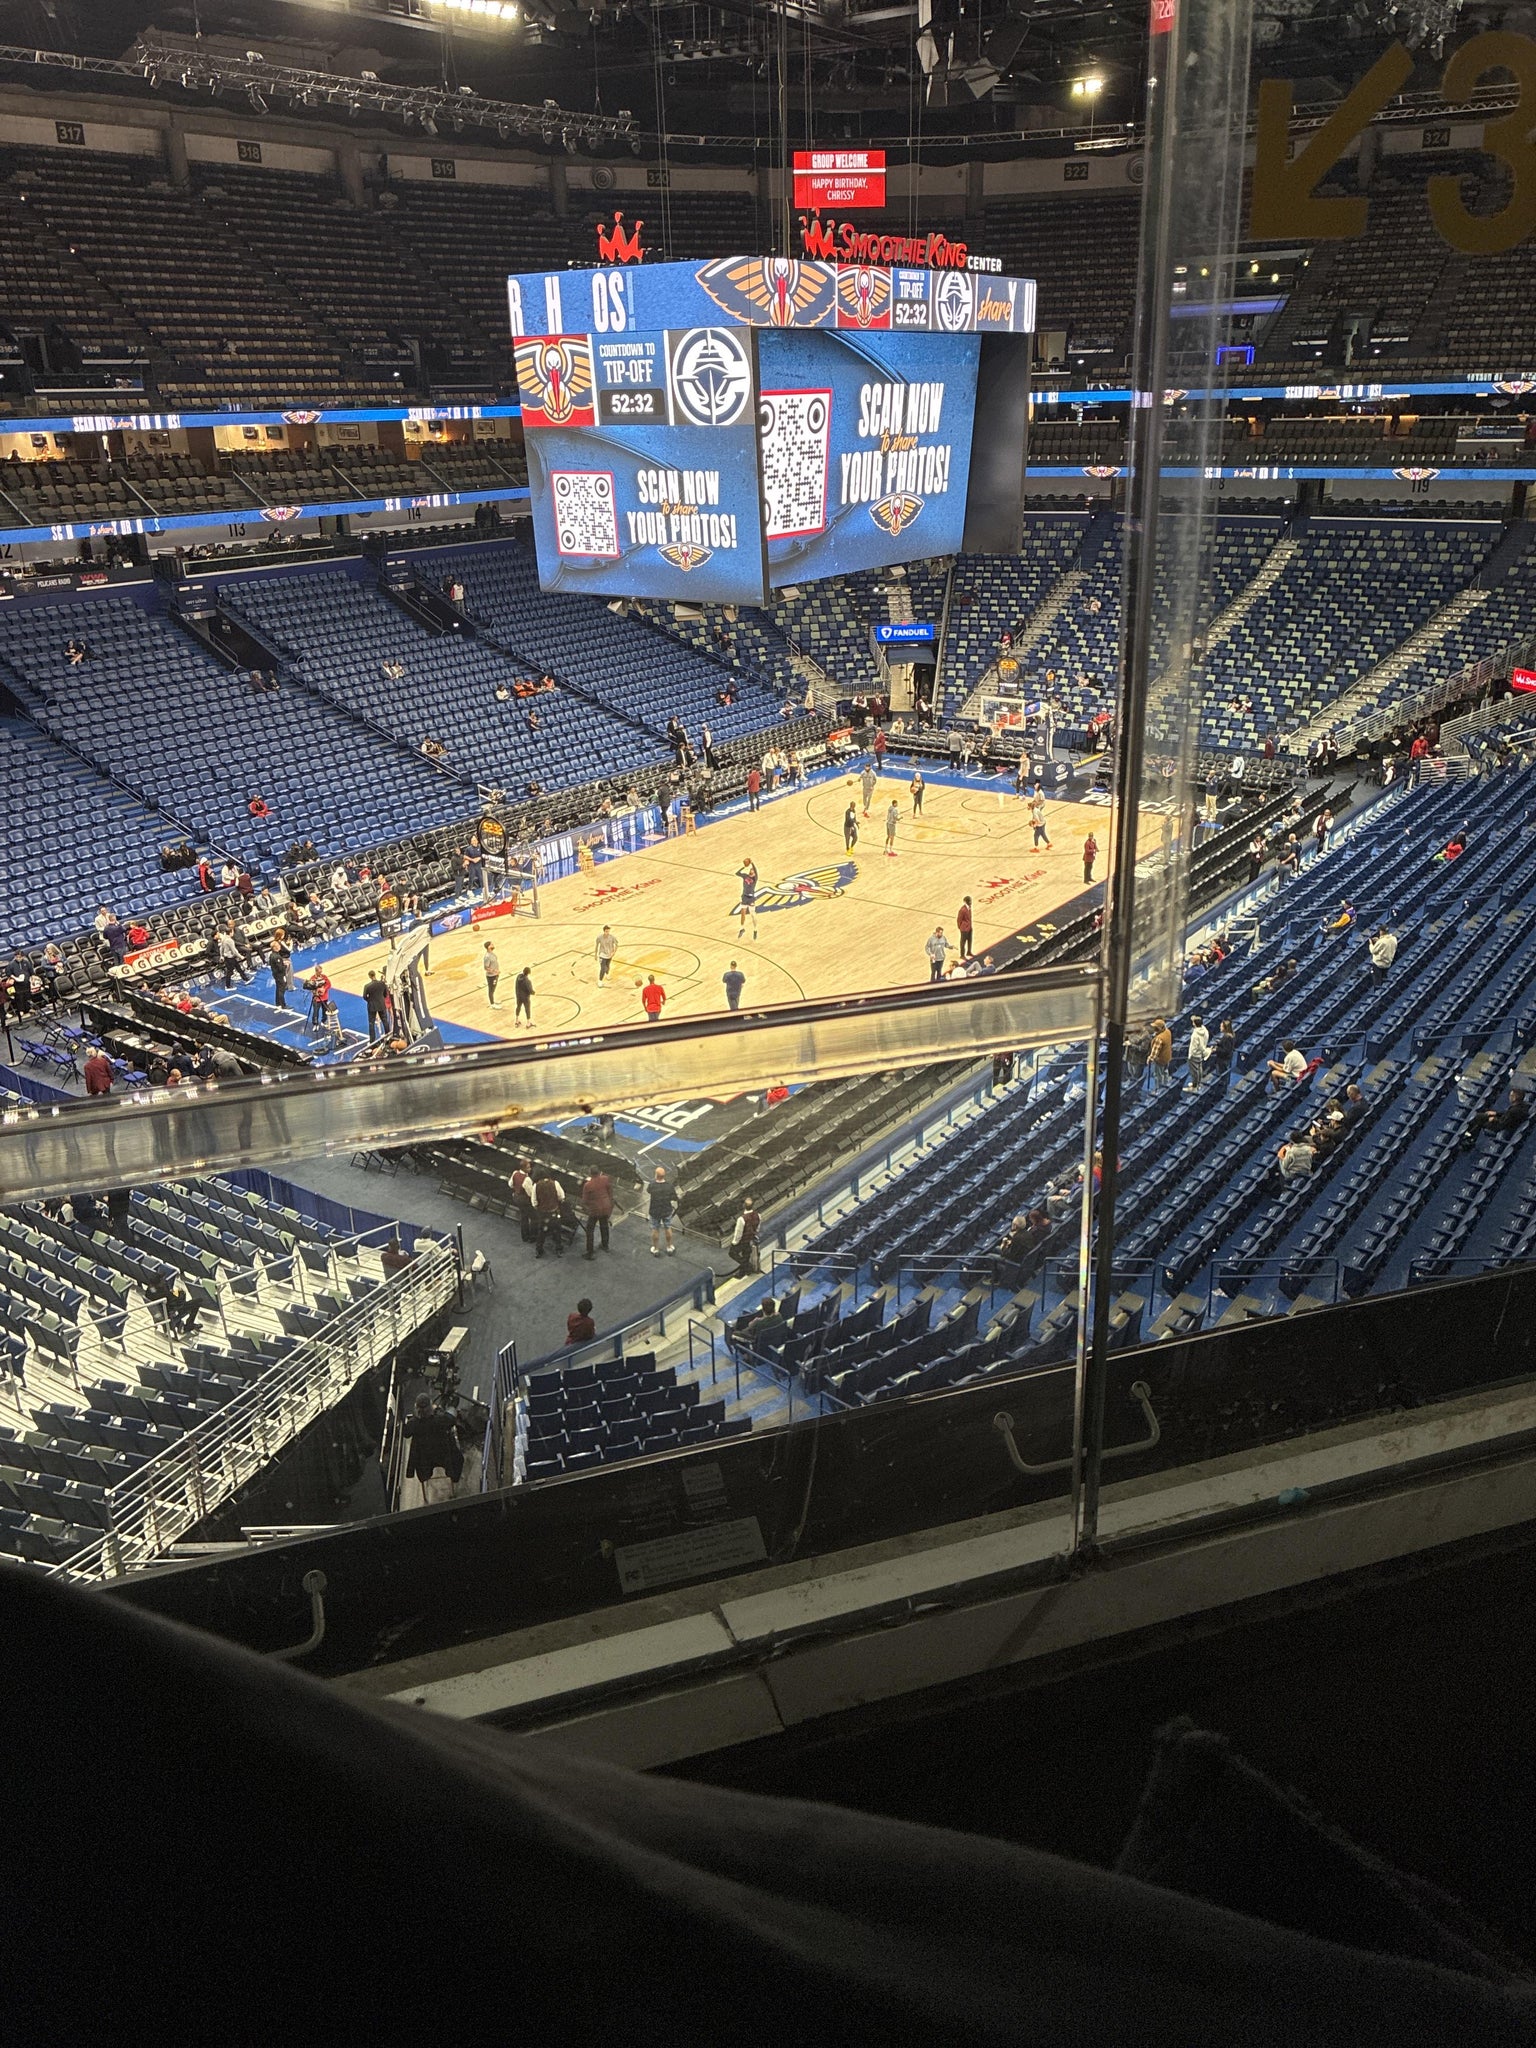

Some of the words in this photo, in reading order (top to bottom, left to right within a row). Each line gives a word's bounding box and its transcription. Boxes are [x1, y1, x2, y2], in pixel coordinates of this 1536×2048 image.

[59, 126, 81, 141] 317
[1424, 132, 1448, 145] 324
[240, 145, 260, 159] 318
[434, 162, 453, 175] 319
[812, 154, 834, 168] GROUP
[835, 154, 868, 168] WELCOME
[1065, 166, 1087, 177] 322
[812, 179, 833, 189] HAPPY
[835, 178, 868, 189] BIRTHDAY,
[827, 190, 855, 200] CHRISSY
[838, 223, 928, 265] SMOOTHIE
[967, 255, 1002, 272] CENTER
[900, 282, 924, 299] TIP-OFF
[978, 287, 1011, 321] share
[896, 304, 926, 325] 52:32
[599, 343, 643, 357] COUNTDOWN
[645, 343, 655, 355] TO
[603, 359, 653, 383] TIP-OFF
[612, 394, 654, 413] 52:32
[859, 383, 905, 438] SCAN
[906, 383, 944, 434] NOW
[880, 429, 889, 456] to
[891, 428, 918, 453] share
[841, 451, 883, 504] YOUR
[886, 445, 951, 495] PHOTOS!
[637, 469, 680, 504] SCAN
[683, 470, 719, 505] NOW
[1412, 480, 1429, 492] 119
[407, 508, 421, 520] 114
[661, 499, 670, 516] to
[672, 499, 698, 516] share
[229, 523, 245, 537] 113
[627, 511, 667, 545] YOUR
[670, 514, 738, 548] PHOTOS!
[1034, 765, 1043, 776] G
[573, 889, 632, 913] SMOOTHIE
[121, 966, 129, 975] G
[138, 960, 146, 969] G
[154, 954, 163, 963] G
[169, 949, 178, 958] G
[185, 945, 193, 954] G
